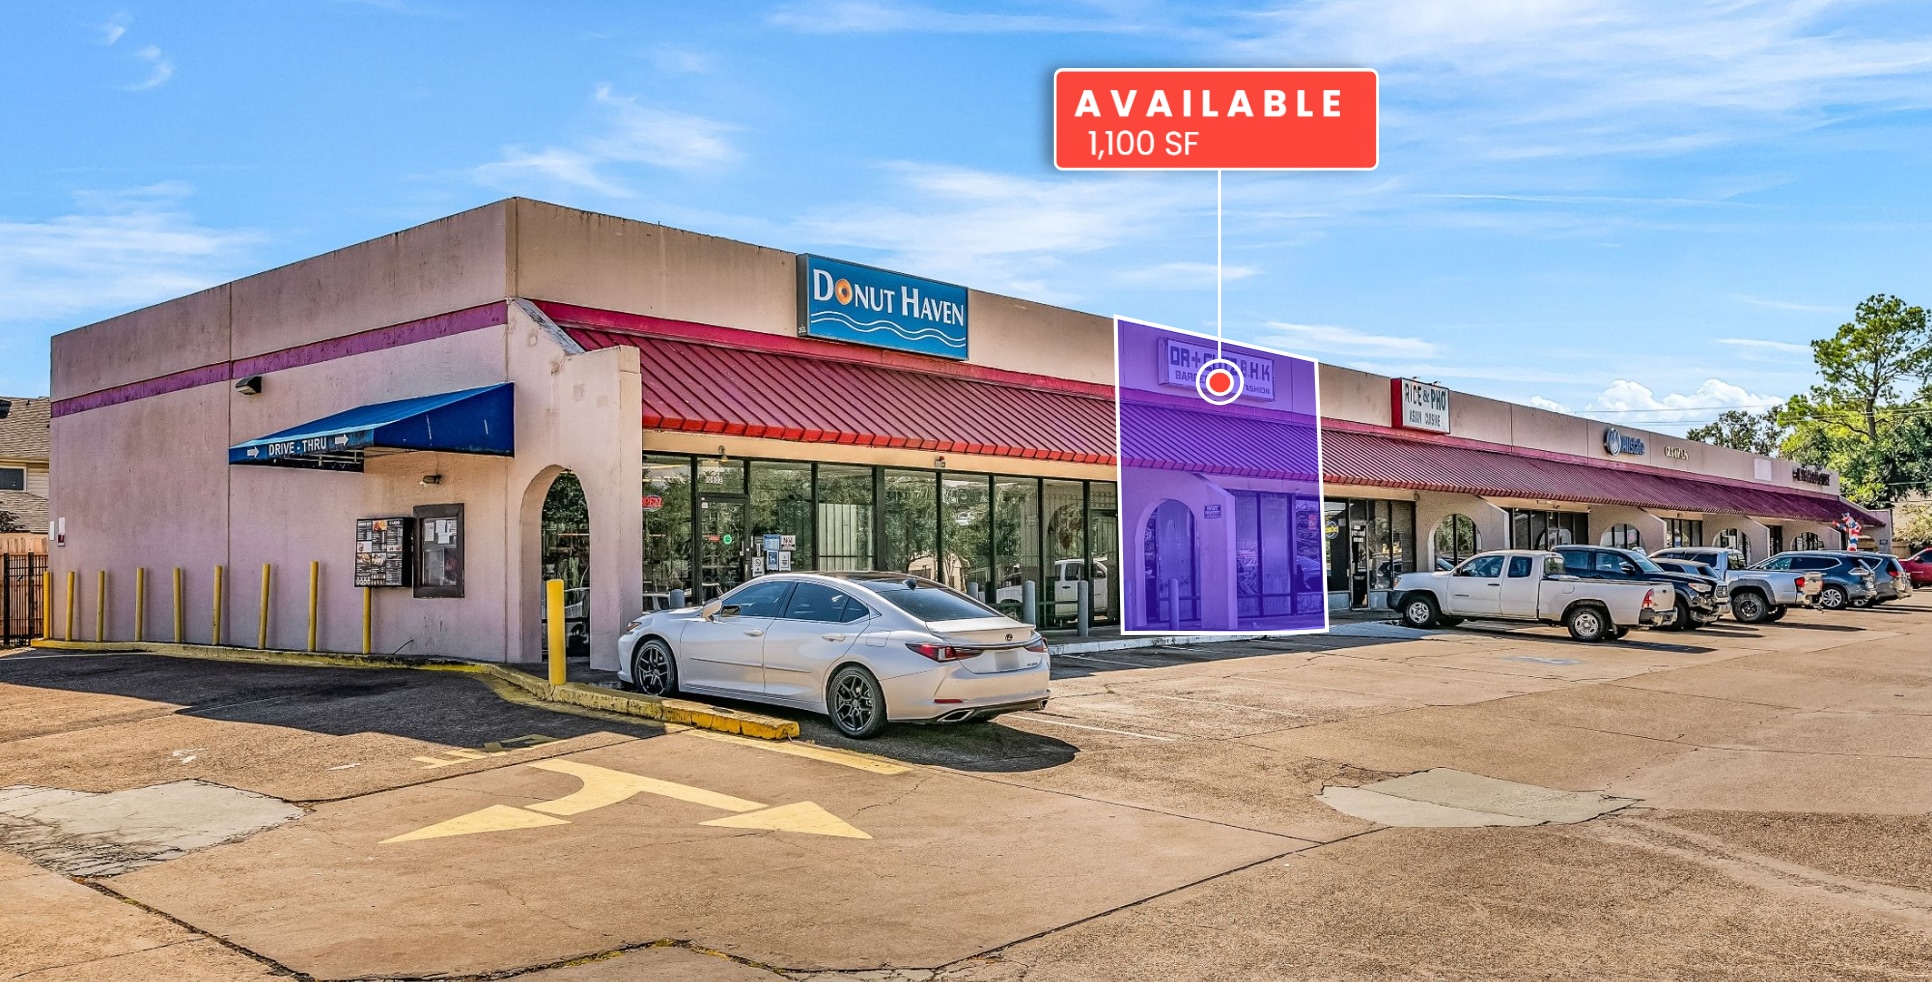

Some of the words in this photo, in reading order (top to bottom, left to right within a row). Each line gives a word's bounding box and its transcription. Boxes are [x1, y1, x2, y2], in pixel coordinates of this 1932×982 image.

[813, 268, 895, 314] DONUT
[901, 285, 964, 327] HAVEN
[1404, 382, 1422, 407] RICE
[1423, 389, 1430, 404] &
[268, 441, 295, 456] DRIVE
[302, 436, 327, 453] THRU
